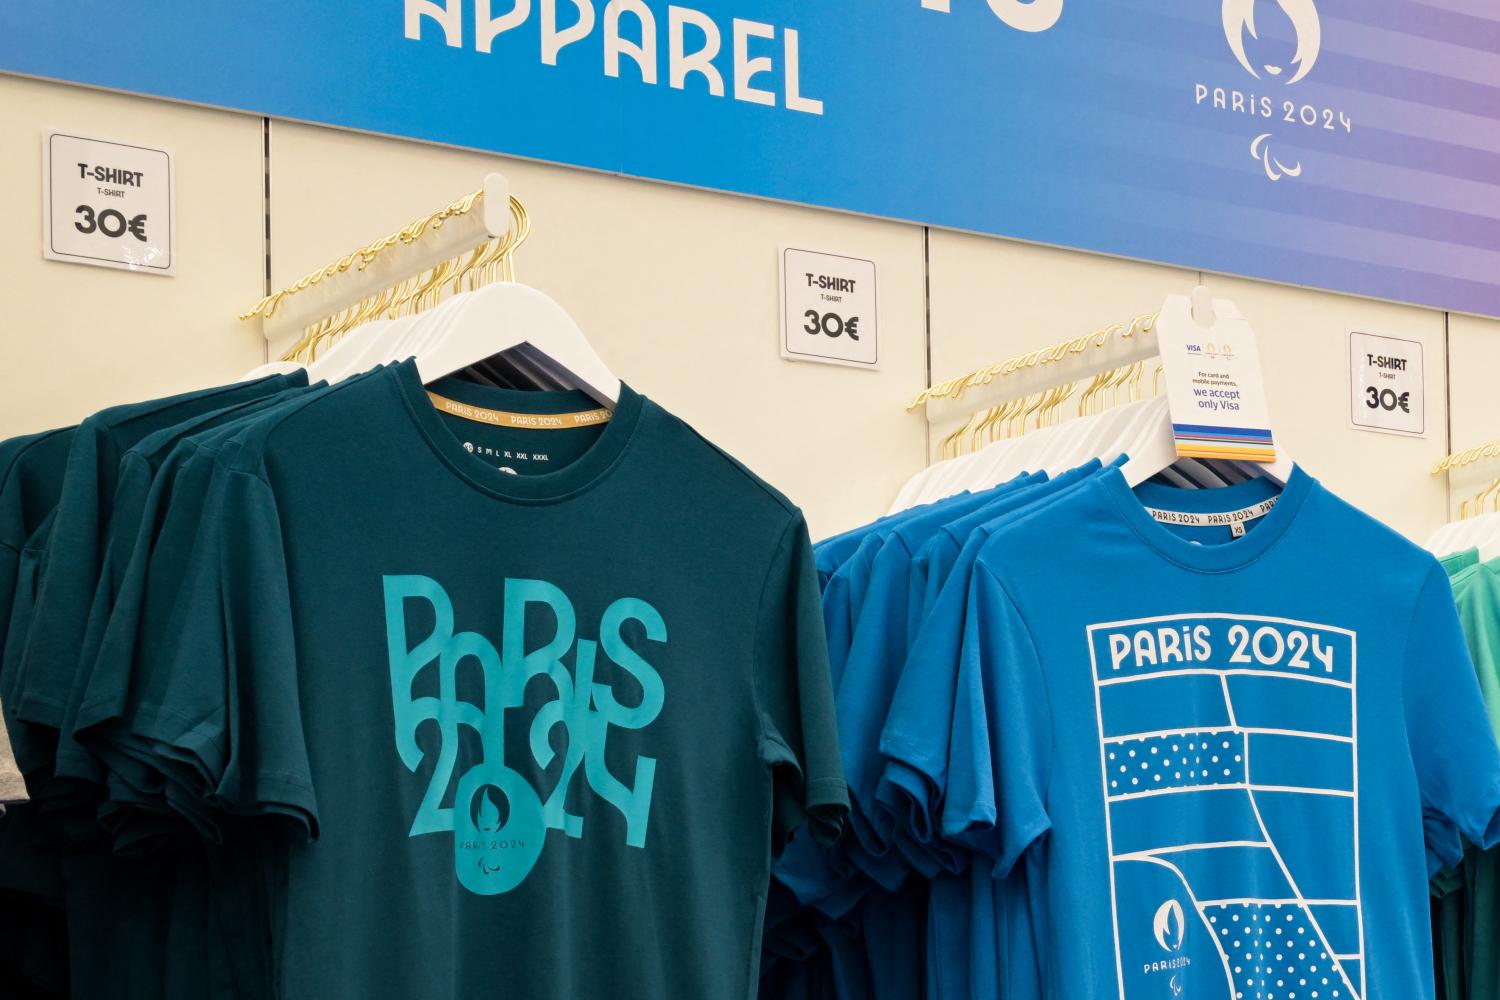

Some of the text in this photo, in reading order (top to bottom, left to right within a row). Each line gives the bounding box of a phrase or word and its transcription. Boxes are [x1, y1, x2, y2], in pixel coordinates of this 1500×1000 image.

[1283, 101, 1352, 133] 2024
[77, 162, 144, 188] T-SHIRT
[97, 187, 125, 198] T-SHIRT
[74, 204, 148, 243] 30€
[805, 272, 856, 294] T-SHIRT
[820, 293, 842, 303] T-SHIRT
[803, 309, 860, 341] 30€
[1186, 344, 1201, 352] VISA
[1366, 353, 1408, 371] T-SHIRT
[1193, 388, 1240, 400] we accept
[1365, 386, 1410, 414] 30€
[1198, 399, 1240, 411] only Visa
[474, 408, 499, 422] 2024
[538, 415, 562, 426] 2024
[600, 409, 613, 421] 20
[1178, 513, 1200, 524] 2024
[1232, 510, 1254, 522] 2024
[1227, 624, 1334, 673] 2024
[490, 839, 525, 849] 2024
